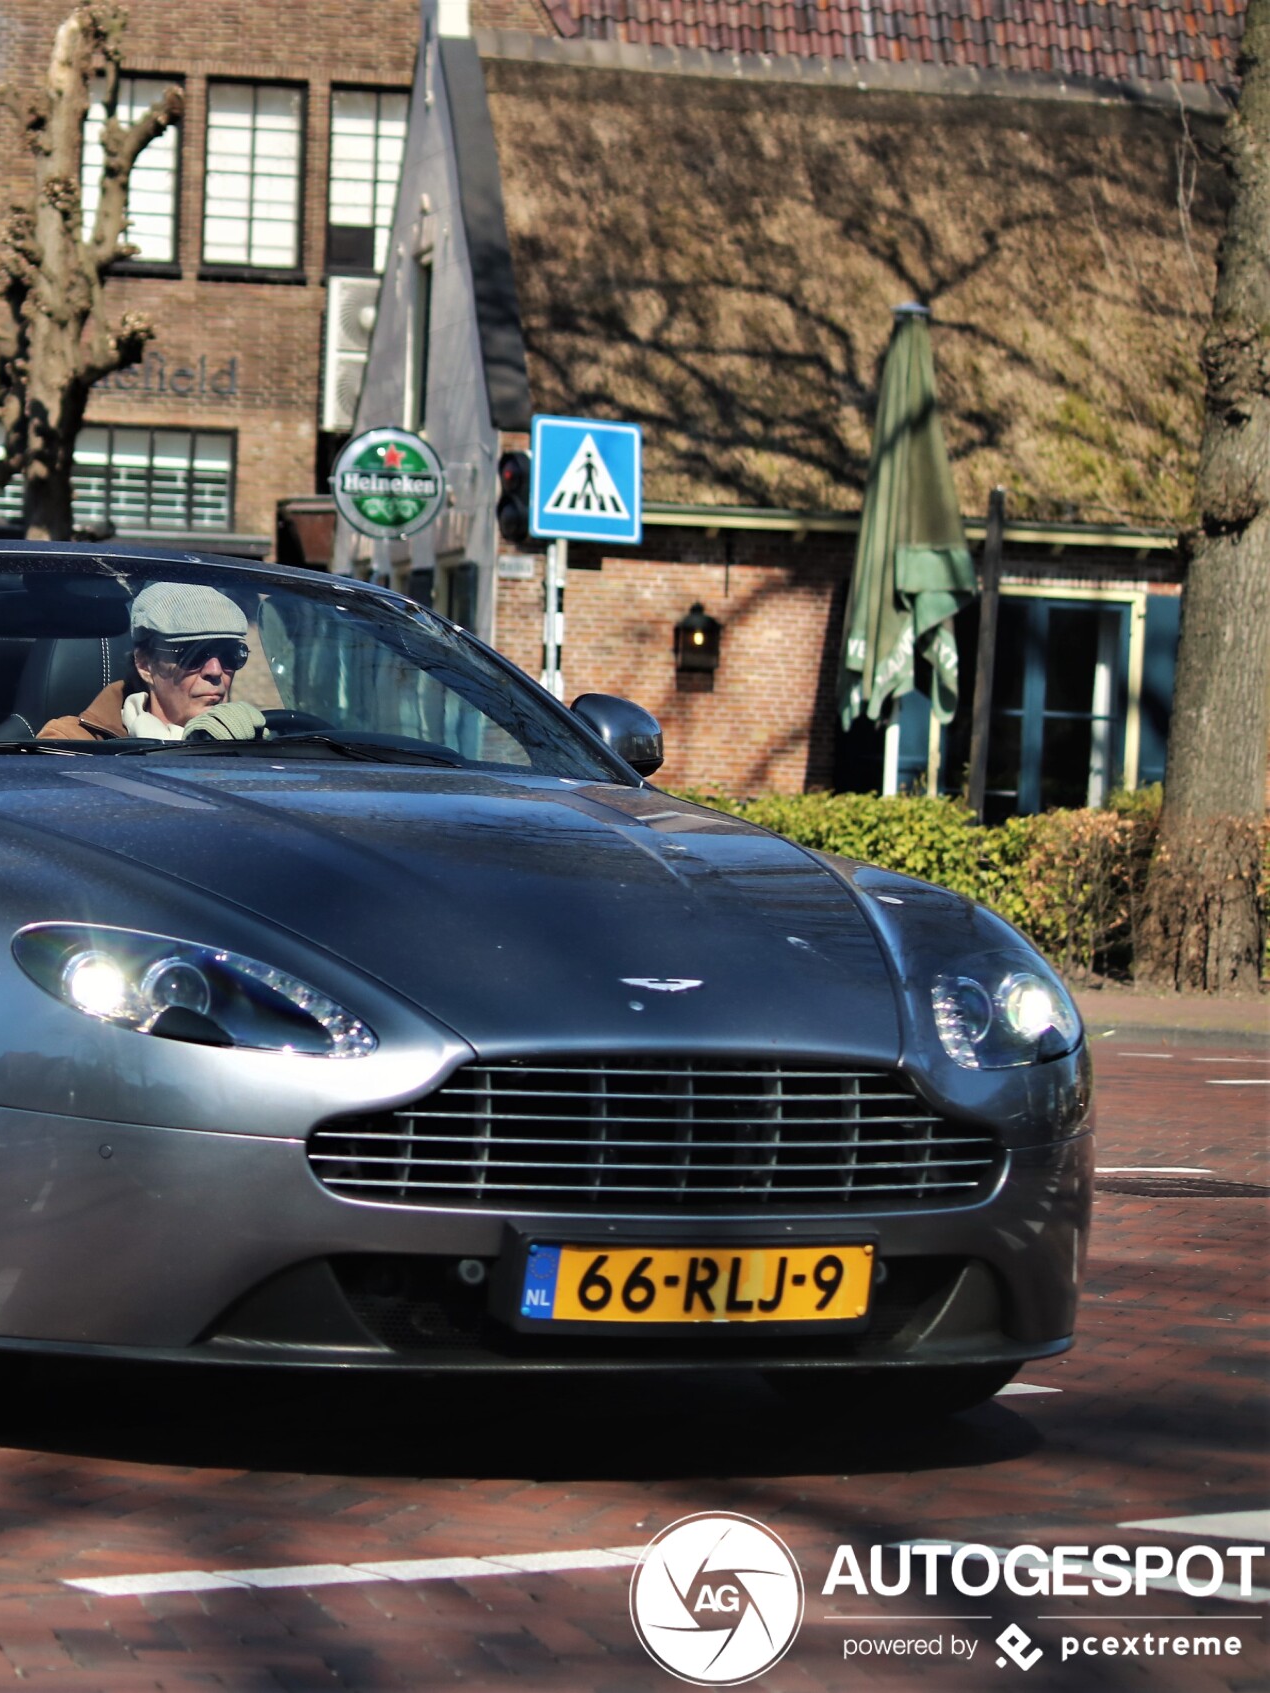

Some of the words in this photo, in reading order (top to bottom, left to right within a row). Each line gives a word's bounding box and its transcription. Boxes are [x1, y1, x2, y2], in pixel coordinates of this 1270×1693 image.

[343, 472, 435, 494] Heineken
[577, 1254, 844, 1314] 66-RLJ-9
[525, 1288, 551, 1307] NL
